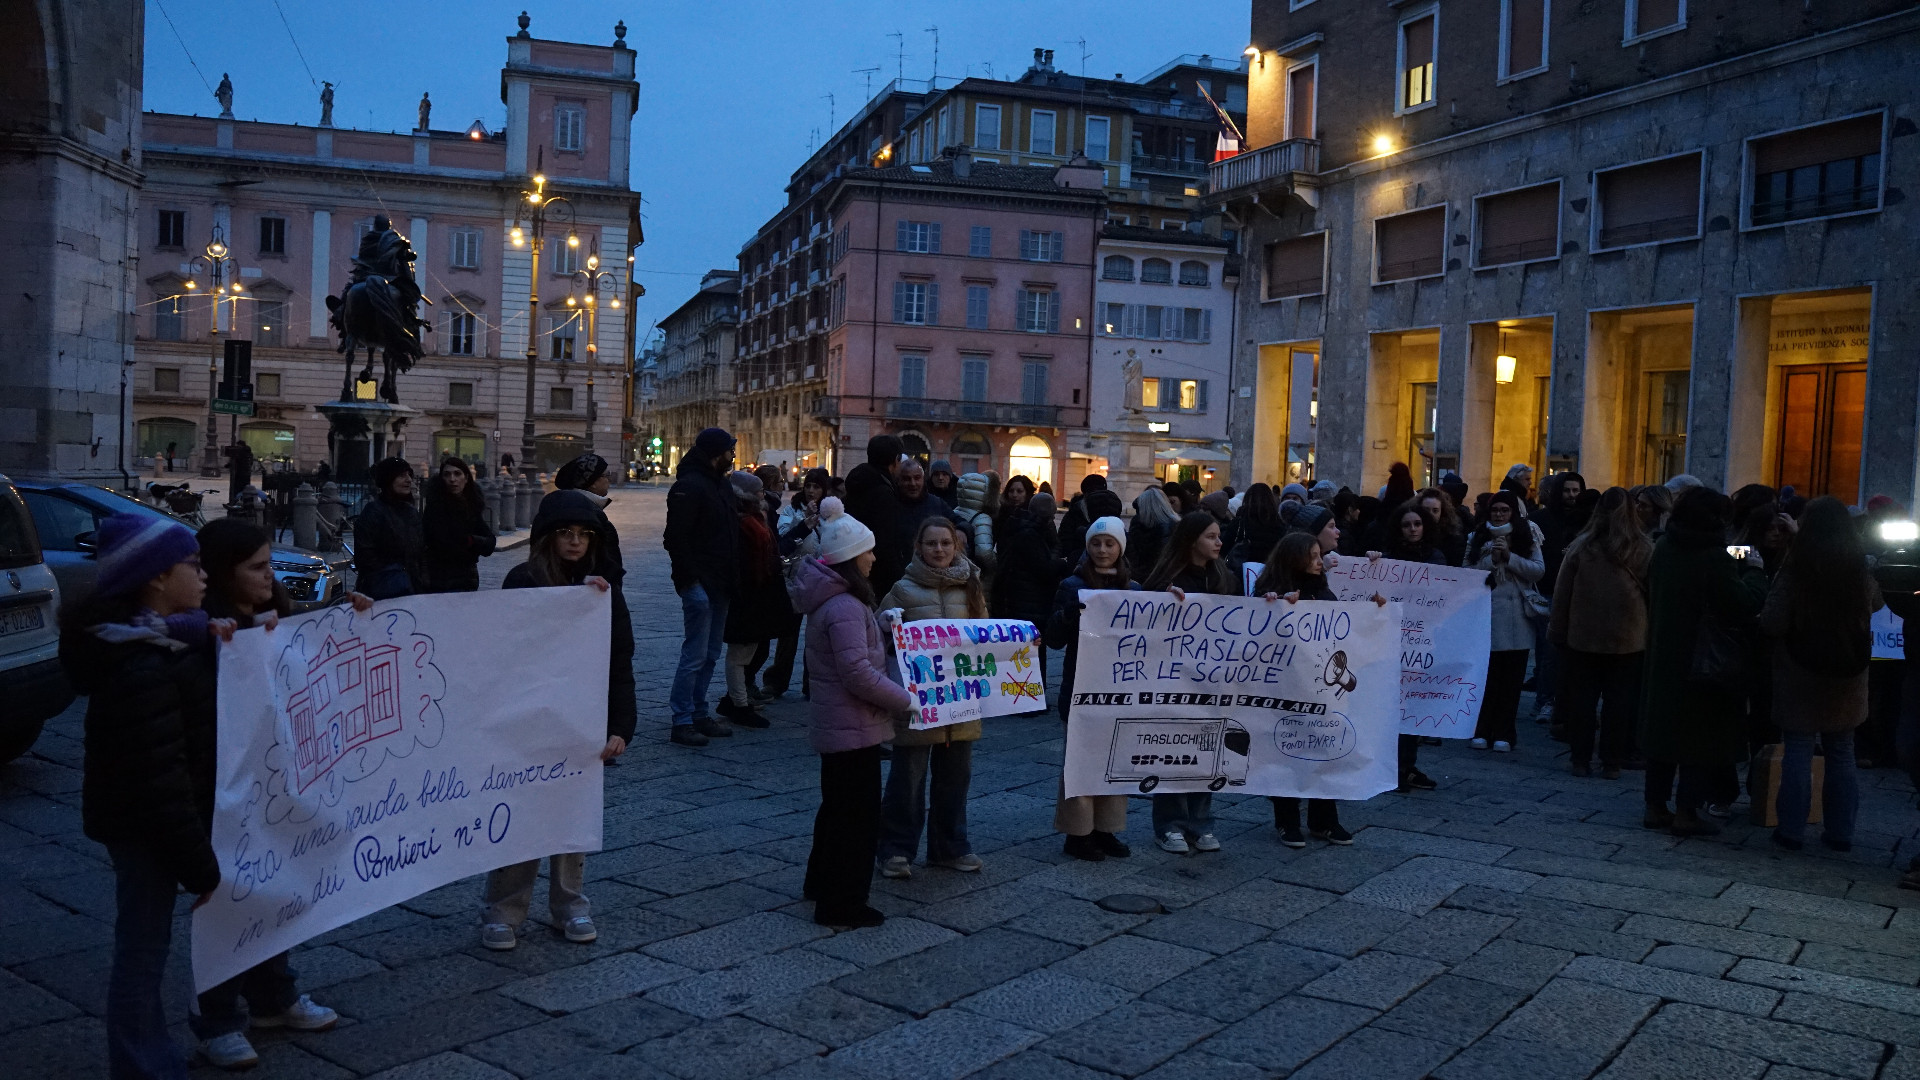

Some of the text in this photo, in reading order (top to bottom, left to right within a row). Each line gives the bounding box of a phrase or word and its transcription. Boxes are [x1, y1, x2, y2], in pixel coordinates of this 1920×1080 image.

[1776, 327, 1815, 339] ISTITUTO
[1792, 339, 1846, 351] PREVIDENZA
[1110, 598, 1350, 642] AMMIOCCUGGINO
[1117, 633, 1296, 666] FA TRASLOCHI
[1112, 661, 1284, 684] PER LE SCUOLE
[1073, 693, 1132, 706] BANCO
[1156, 694, 1216, 705] SEDIA
[1238, 695, 1326, 714] SCOLARO
[1281, 718, 1304, 726] TUTTO
[1136, 734, 1200, 745] TRASLOCHI
[1281, 730, 1297, 739] CON
[1281, 740, 1305, 751] FONDI
[232, 833, 282, 902] Era
[290, 822, 341, 860] una
[345, 778, 409, 833] scuola
[417, 766, 470, 808] bella
[234, 917, 263, 952] in
[276, 891, 305, 928] via
[312, 866, 345, 904] dei
[354, 828, 441, 882] Pontieri
